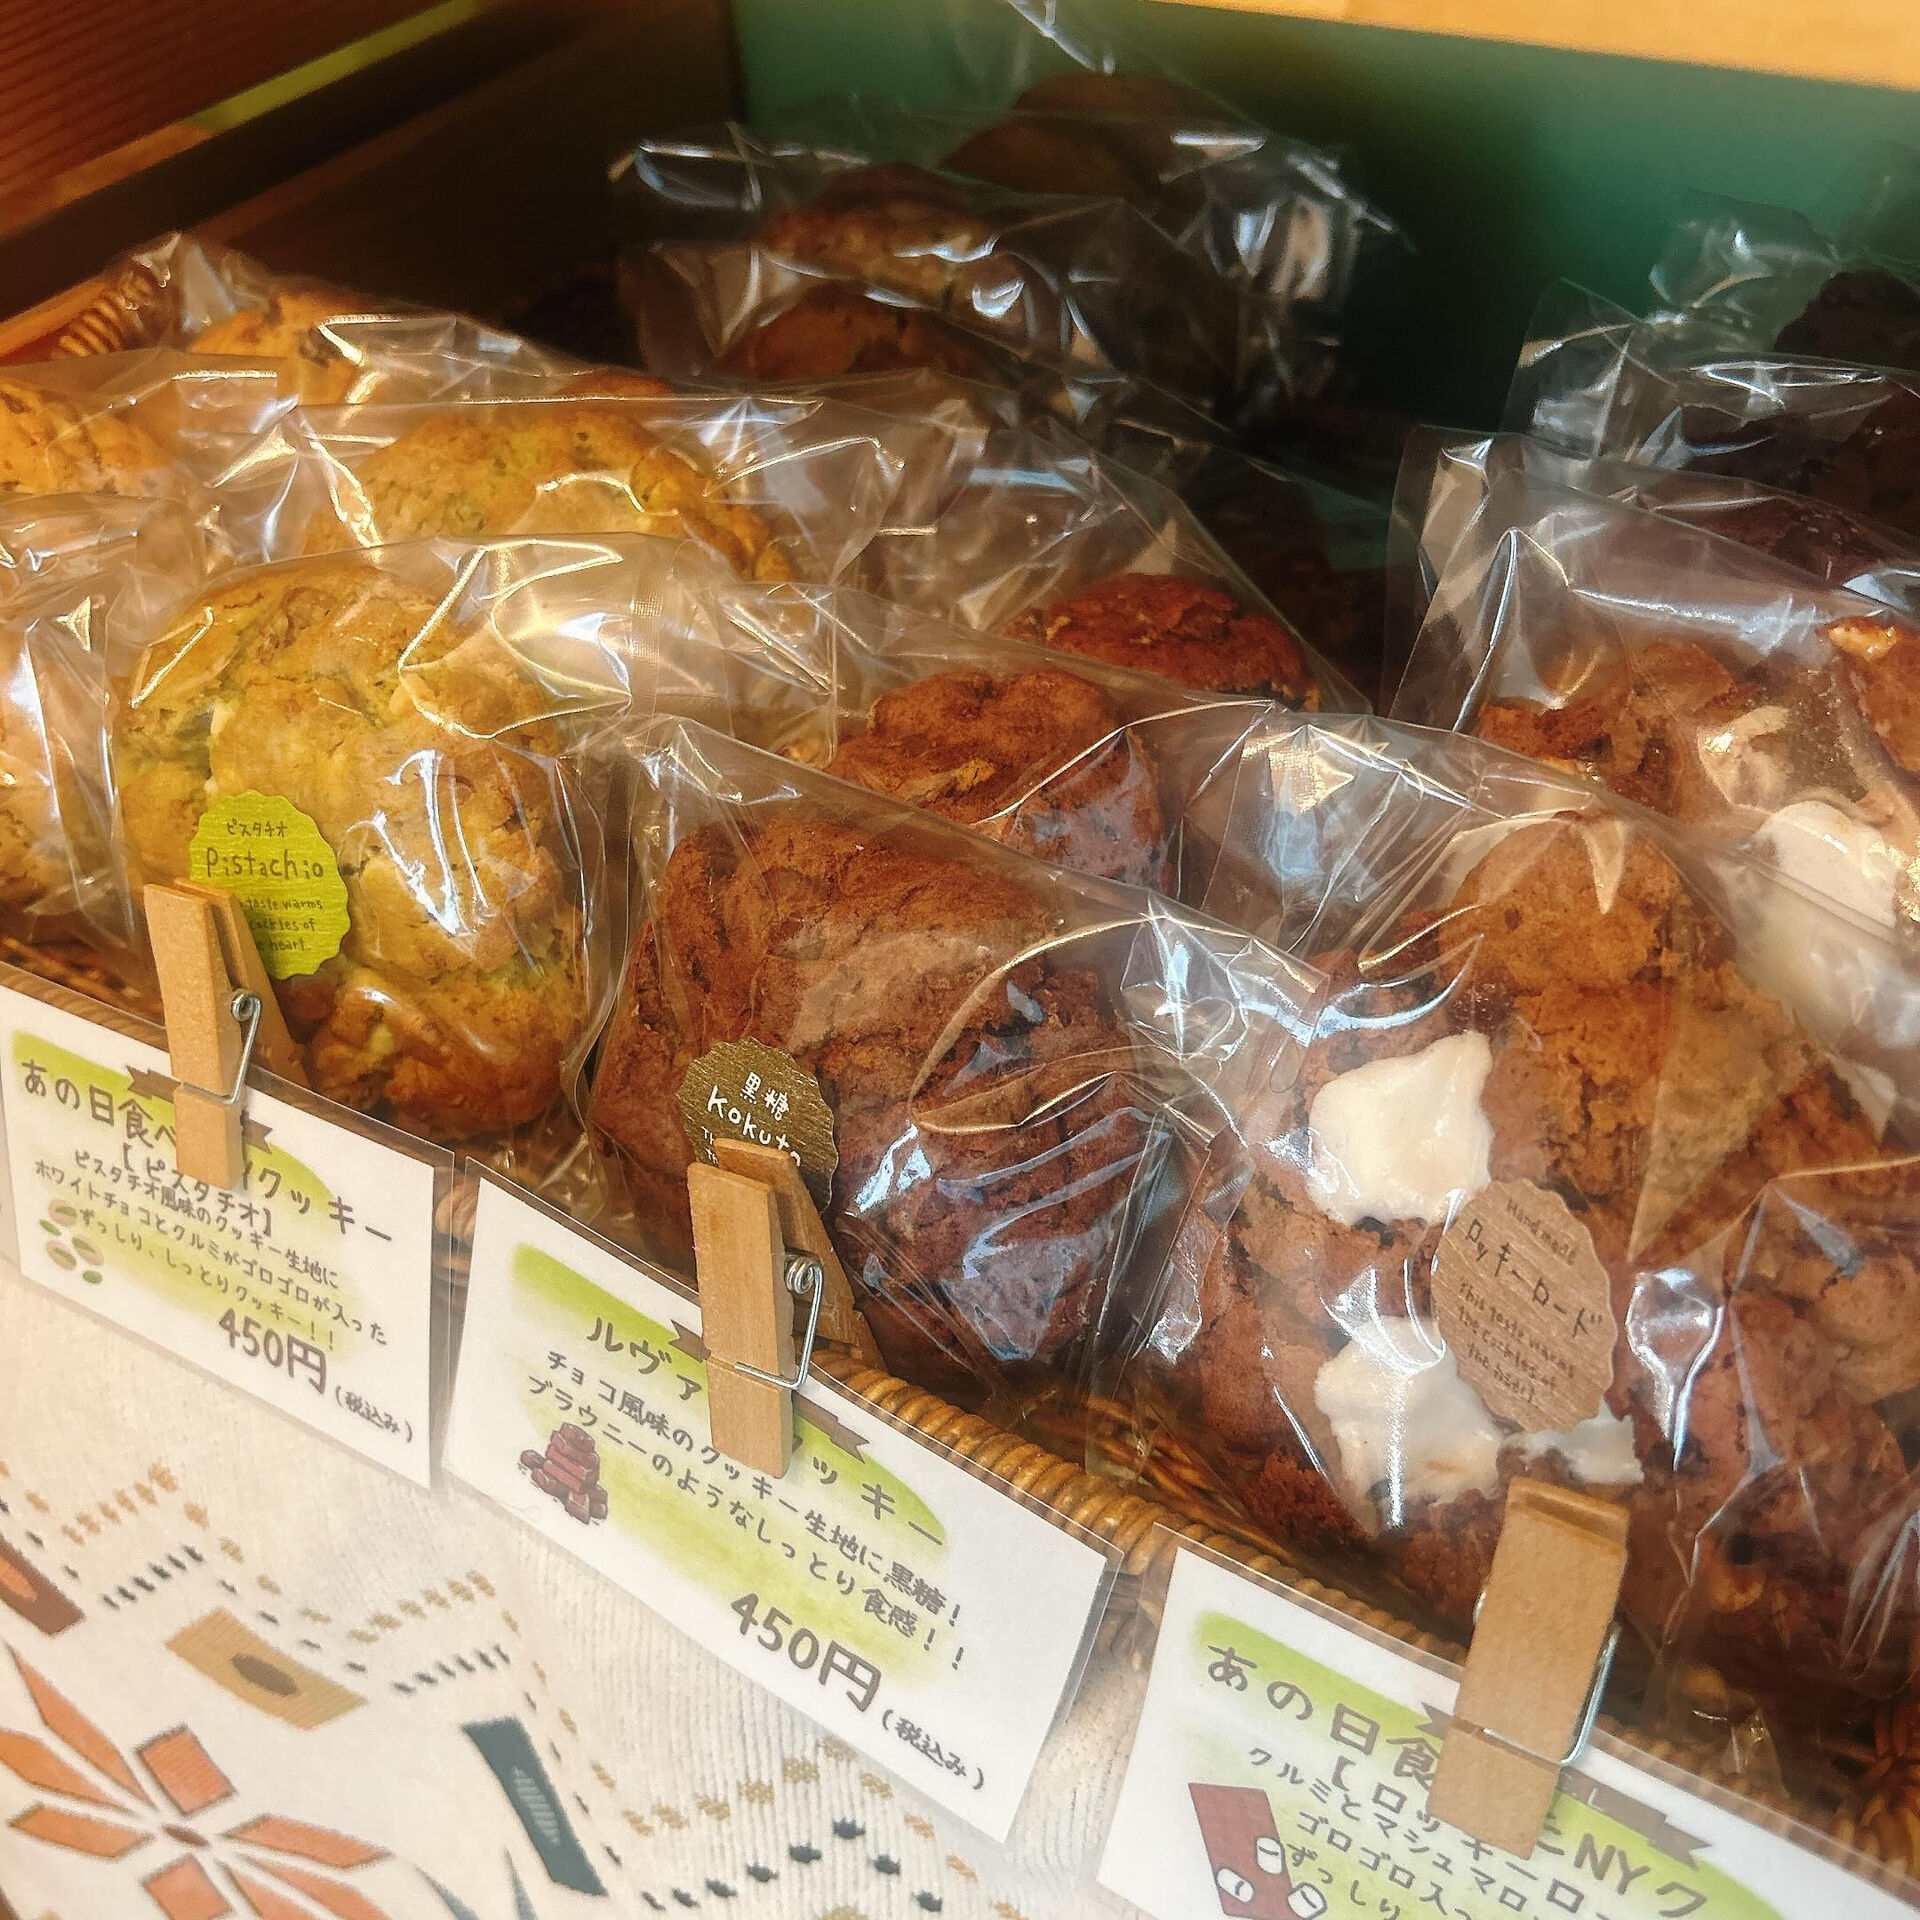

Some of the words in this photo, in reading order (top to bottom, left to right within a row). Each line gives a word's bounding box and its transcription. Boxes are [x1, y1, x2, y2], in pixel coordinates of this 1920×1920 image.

[206, 847, 324, 880] Pistachio
[227, 818, 288, 836] ピスタチオ
[22, 1059, 393, 1243] あの日食べクッキー
[739, 1071, 790, 1121] 黒糖
[74, 1151, 340, 1289] ピスタチオ風味のクッキー生地に
[217, 1307, 328, 1395] 450円
[546, 1351, 962, 1627] チョコ風味のクッキー生地に黒糖！
[586, 1317, 943, 1546] ルヴァッキー
[528, 1376, 964, 1671] ブラウニーのようなしっとり食感！！
[730, 1593, 882, 1711] 450円
[1206, 1643, 1709, 1918] あの日食NYク
